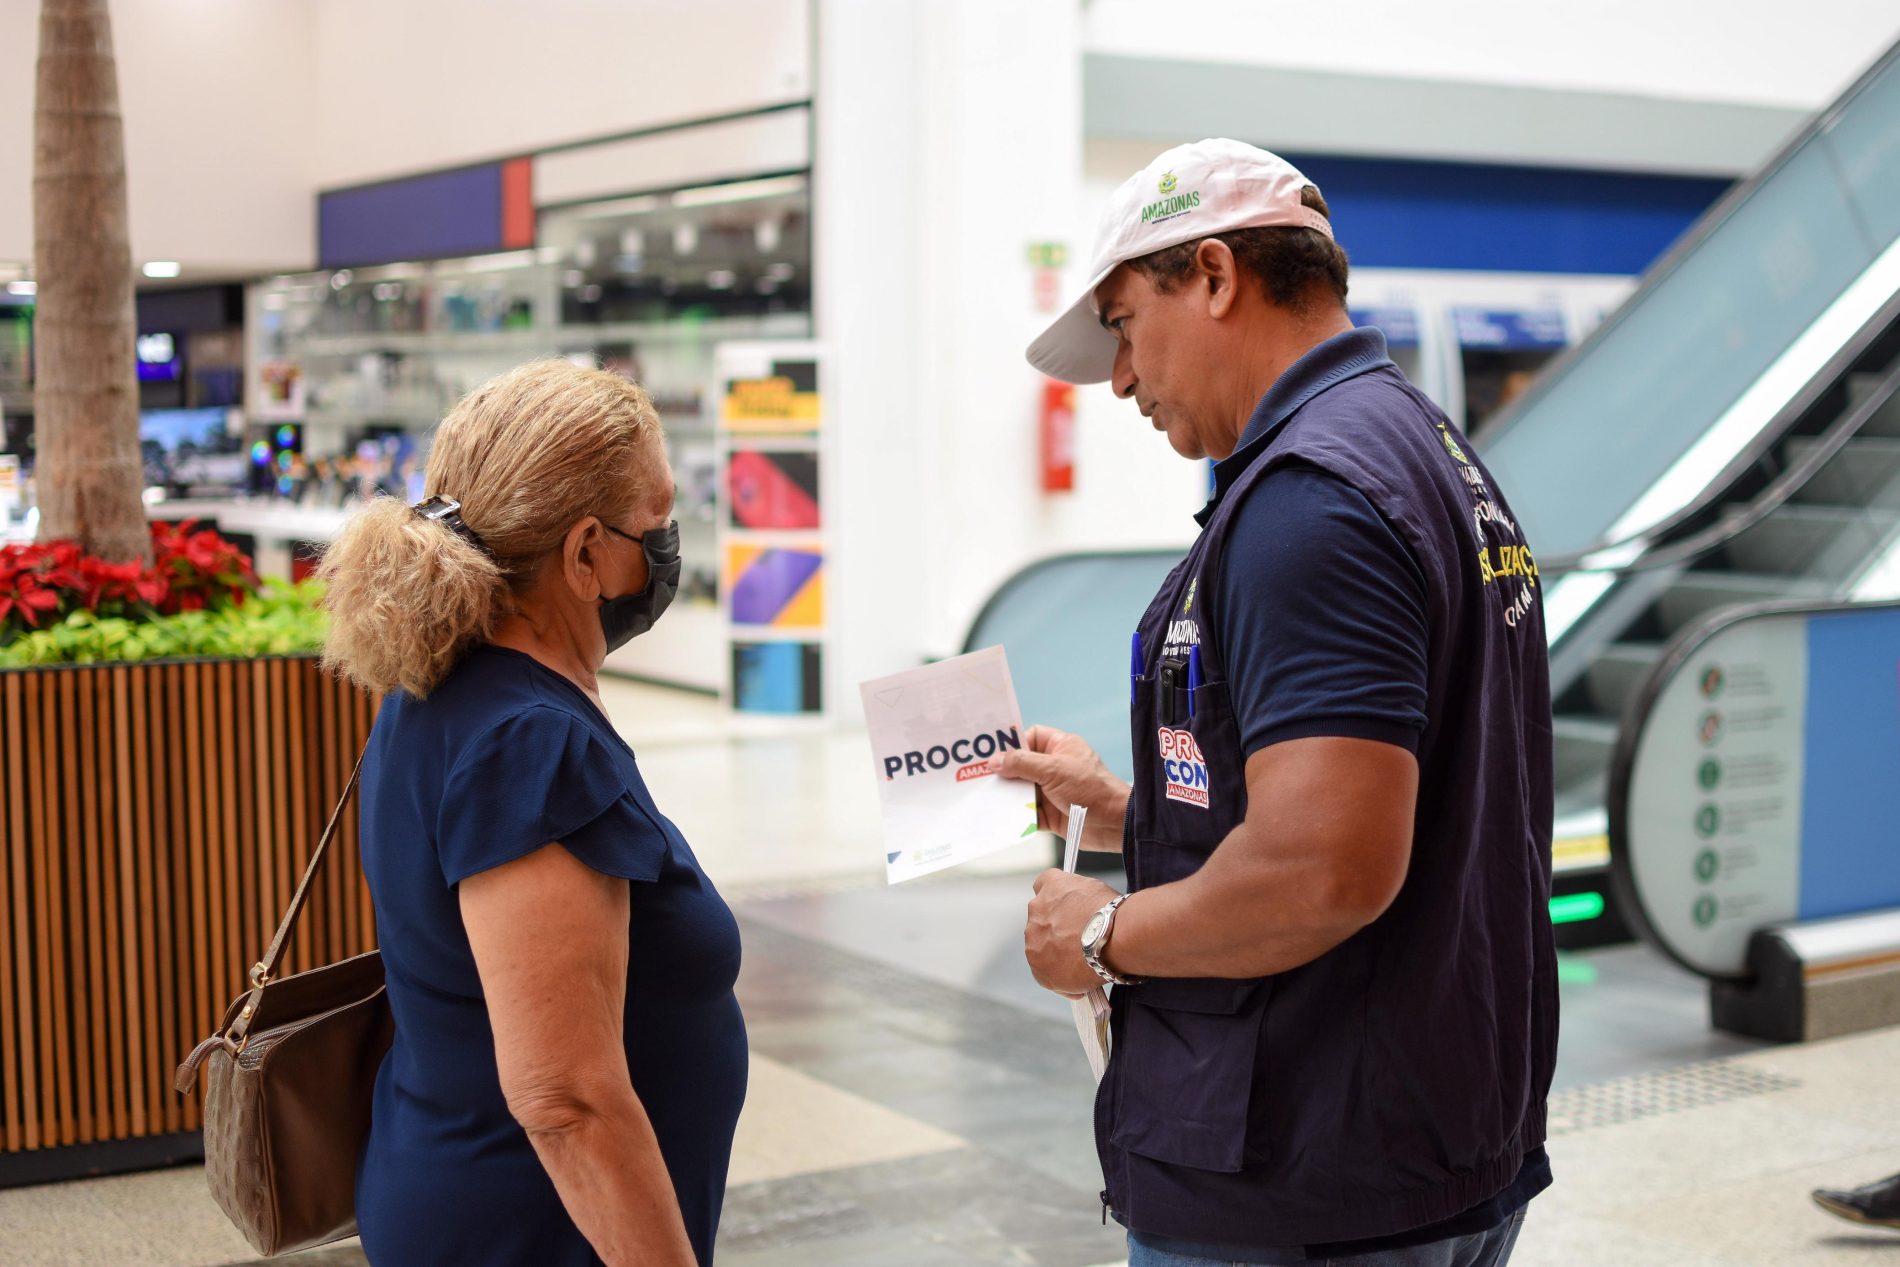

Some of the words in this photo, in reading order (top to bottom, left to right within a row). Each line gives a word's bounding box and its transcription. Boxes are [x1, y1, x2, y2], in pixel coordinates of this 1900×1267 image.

[1141, 190, 1200, 223] AMAZONAS
[883, 725, 1022, 780] PROCON
[959, 763, 992, 780] AMAZ
[1165, 759, 1207, 789] CON
[1168, 784, 1208, 804] AMAZONAS
